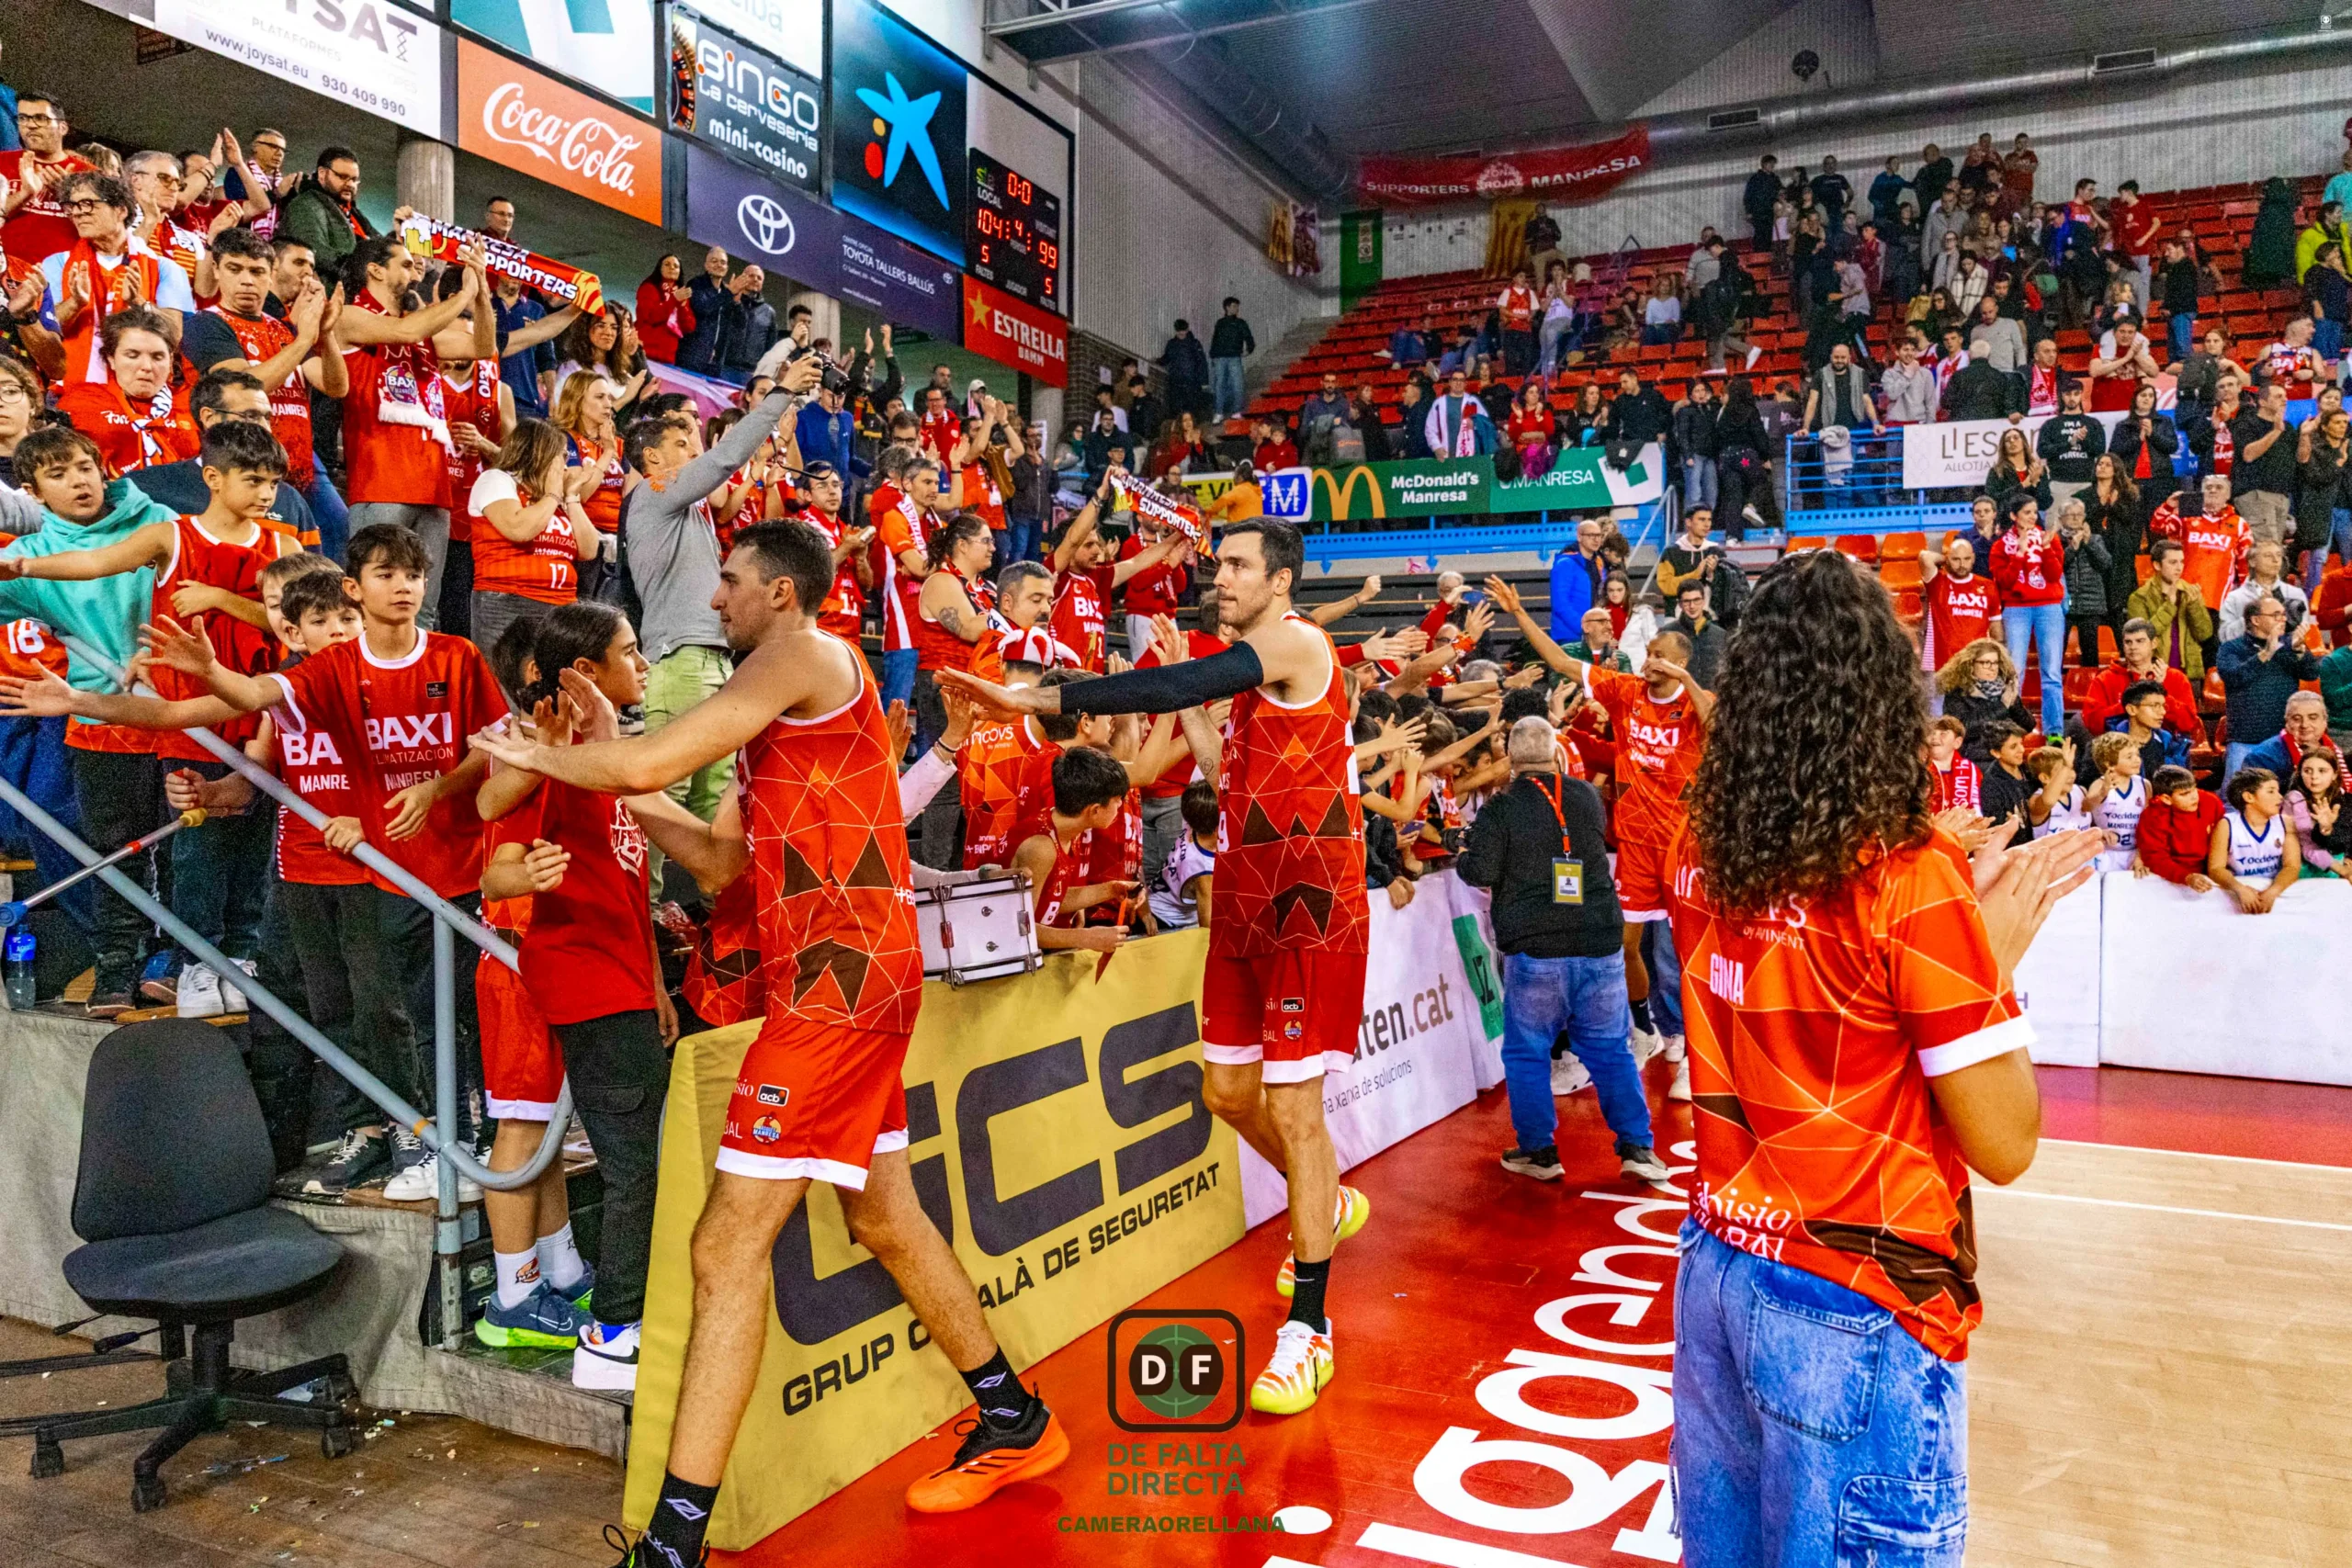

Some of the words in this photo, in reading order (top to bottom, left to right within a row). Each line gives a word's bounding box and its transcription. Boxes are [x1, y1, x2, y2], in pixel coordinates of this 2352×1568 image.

[252, 17, 343, 62] PLATAFORMES
[205, 28, 310, 79] www.joysat.eu
[322, 74, 348, 95] 930
[352, 86, 378, 107] 409
[381, 98, 406, 117] 990
[708, 118, 808, 180] mini-casino
[977, 186, 1003, 210] LOCAL
[1366, 182, 1470, 195] SUPPORTERS
[978, 208, 1004, 240] 104
[1014, 220, 1023, 237] 4
[1038, 241, 1057, 269] 99
[457, 243, 579, 301] SPPORTERS
[842, 243, 875, 269] TOYOTA
[875, 258, 907, 283] TALLERS
[981, 244, 989, 264] 5
[1045, 276, 1054, 295] 5
[993, 309, 1066, 363] ESTRELLA
[1018, 345, 1045, 367] DAMM
[388, 375, 415, 389] BAX
[1401, 490, 1468, 505] Manresa
[1138, 497, 1204, 544] SUPPORTERS
[2187, 531, 2233, 551] BAXI
[549, 562, 569, 590] 17
[6, 618, 46, 654] 18
[365, 711, 454, 751] BAXI
[1709, 952, 1745, 1006] GINA
[1352, 972, 1454, 1065] ten.cat
[759, 1092, 781, 1103] acb
[1335, 1084, 1362, 1111] xarxa
[1362, 1076, 1374, 1097] de
[1374, 1059, 1413, 1090] solucions
[782, 1332, 896, 1417] GRUP
[908, 1257, 1035, 1353] CALÀ
[1043, 1236, 1081, 1280] DE
[1088, 1161, 1221, 1254] SEGURETAT
